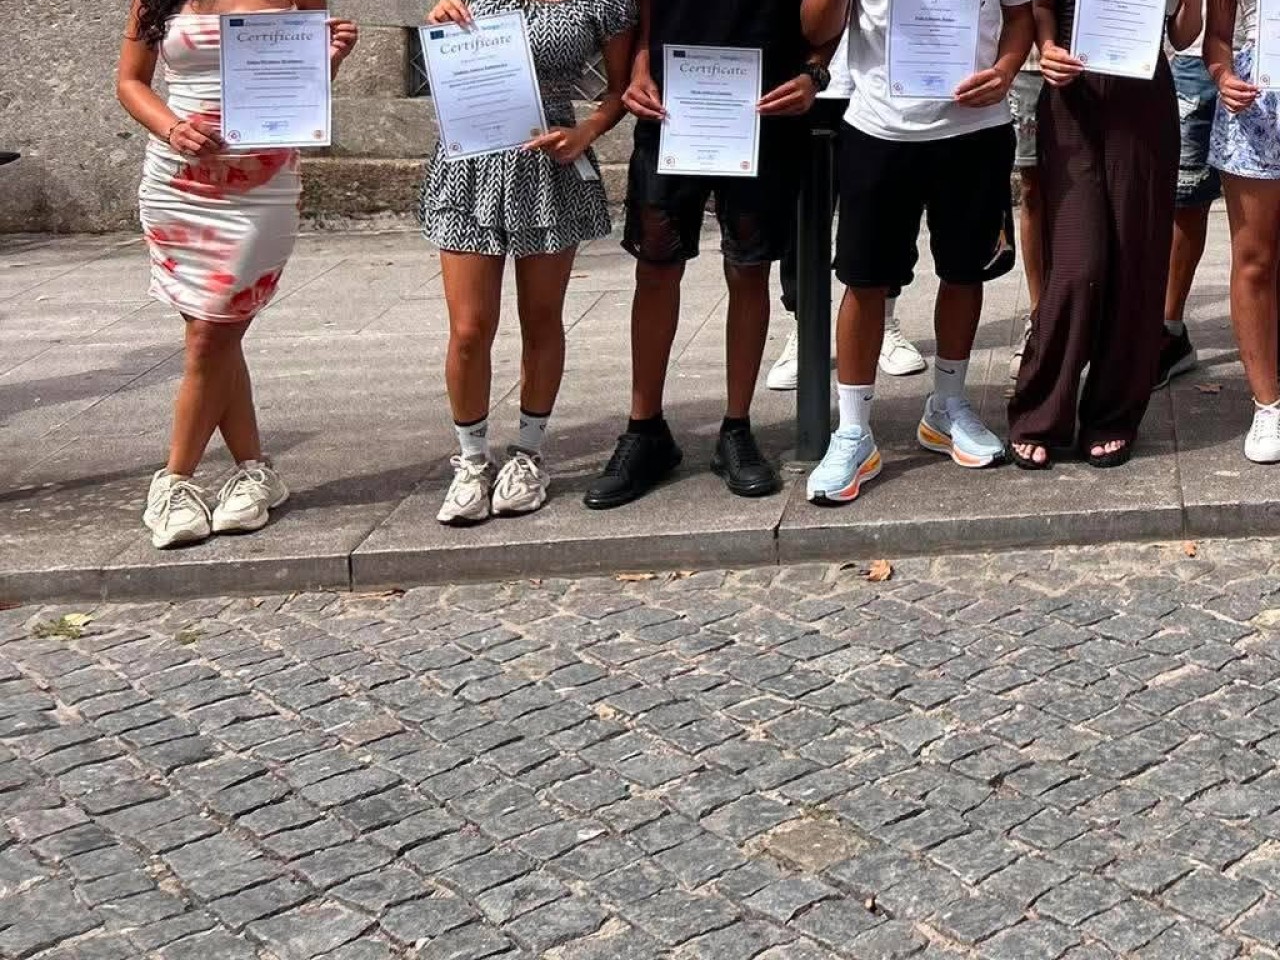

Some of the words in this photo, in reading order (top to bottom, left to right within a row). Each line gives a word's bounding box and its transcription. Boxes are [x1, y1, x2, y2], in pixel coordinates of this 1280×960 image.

[237, 29, 313, 45] Certificate
[440, 35, 513, 54] Certificate
[680, 62, 748, 76] Certificate
